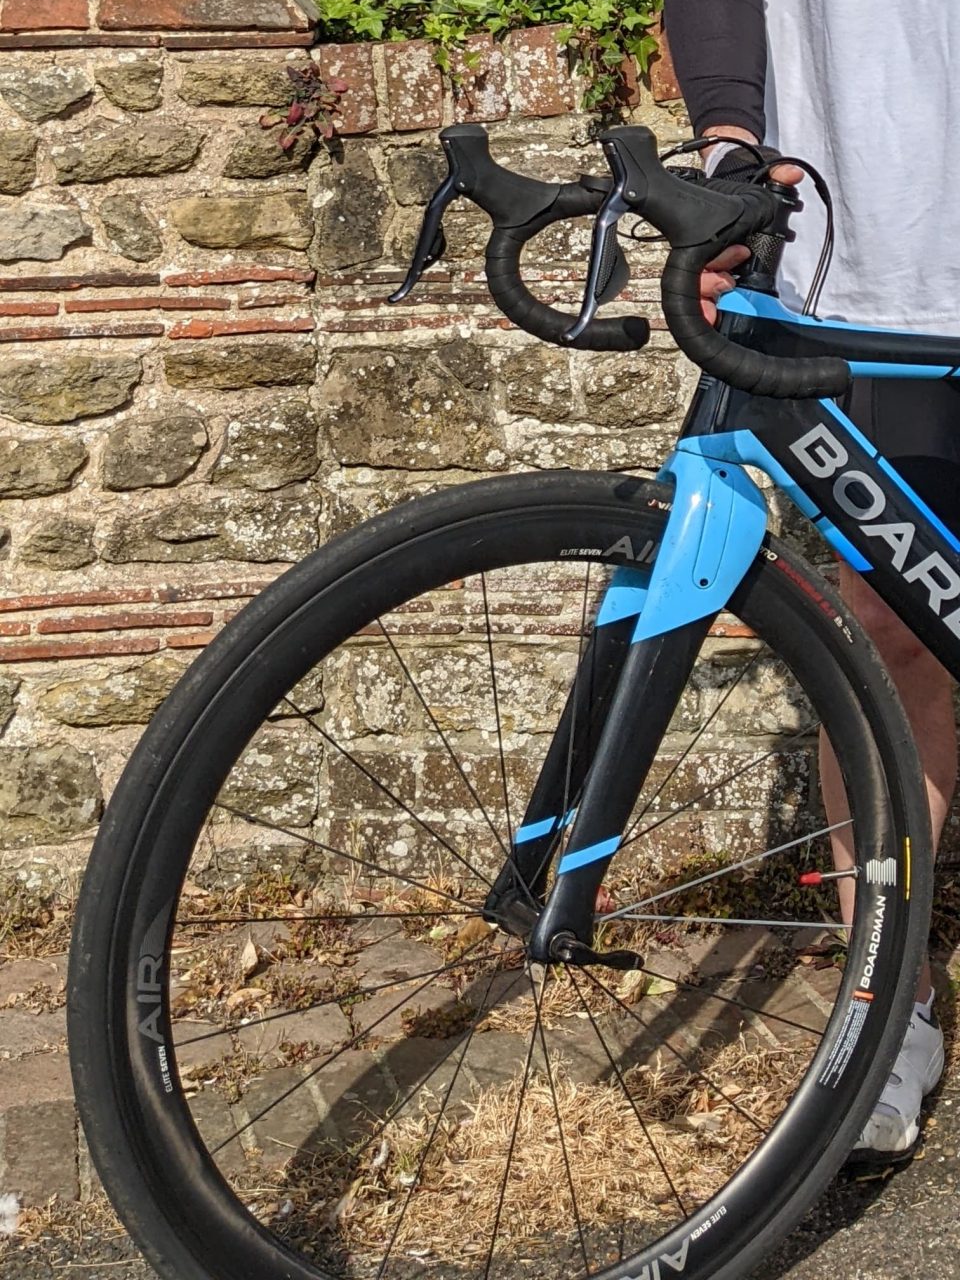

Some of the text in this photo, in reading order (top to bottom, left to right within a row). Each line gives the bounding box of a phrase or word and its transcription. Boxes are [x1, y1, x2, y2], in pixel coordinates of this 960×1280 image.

[560, 549, 580, 557] ELITE
[579, 548, 602, 557] SEVEN
[860, 895, 886, 990] BOARDMAN
[136, 954, 165, 1045] AIR
[158, 1045, 173, 1094] ELITE SEVEN
[690, 1221, 712, 1241] SEVEN
[711, 1205, 728, 1224] ELITE
